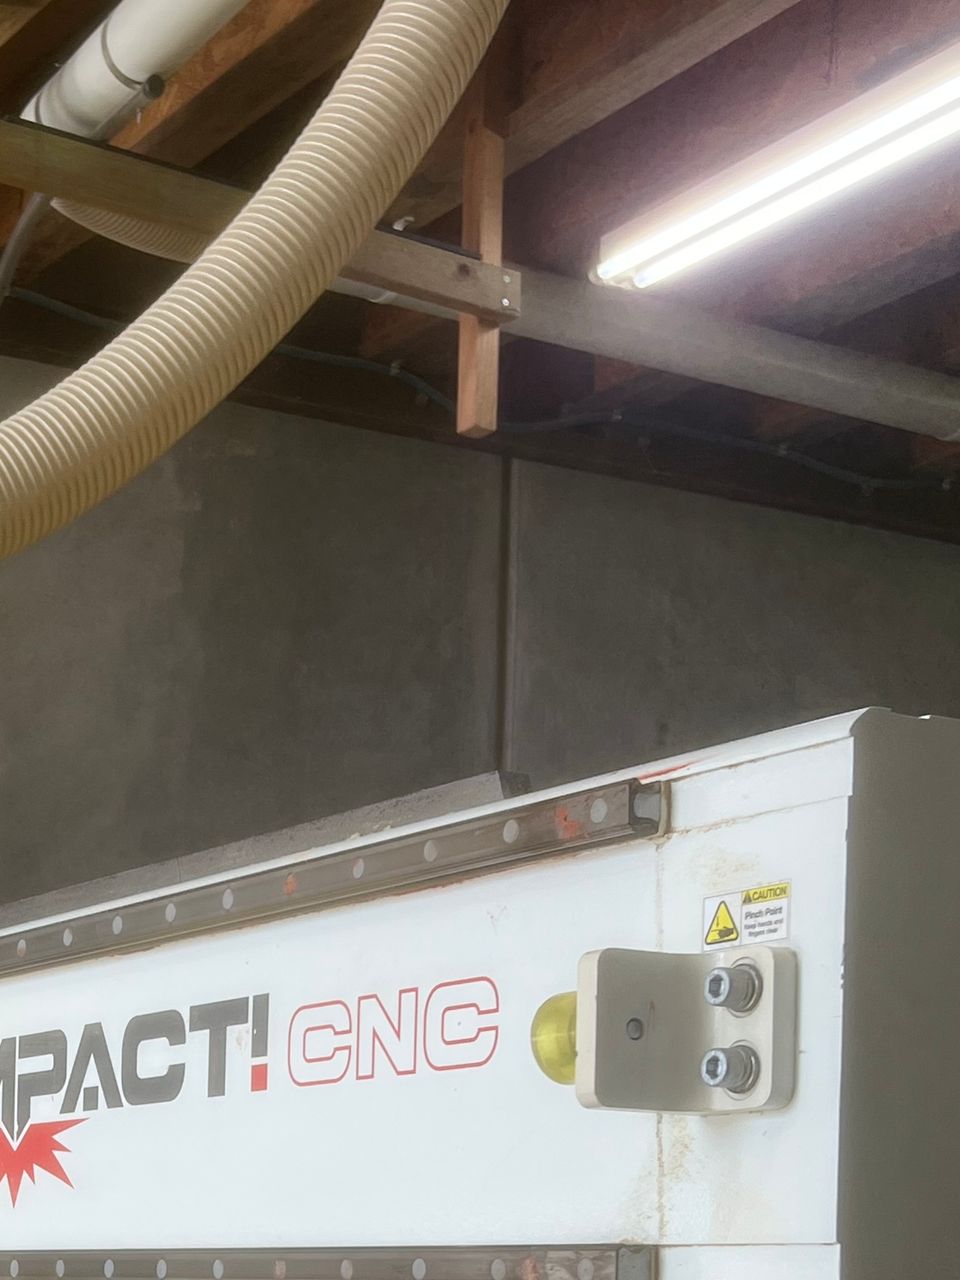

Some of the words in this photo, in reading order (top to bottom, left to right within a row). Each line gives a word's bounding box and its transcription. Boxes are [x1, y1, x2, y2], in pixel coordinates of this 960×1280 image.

[752, 886, 788, 901] CAUTION
[744, 910, 764, 920] Pinch
[765, 906, 783, 916] Point
[287, 976, 500, 1087] CNC
